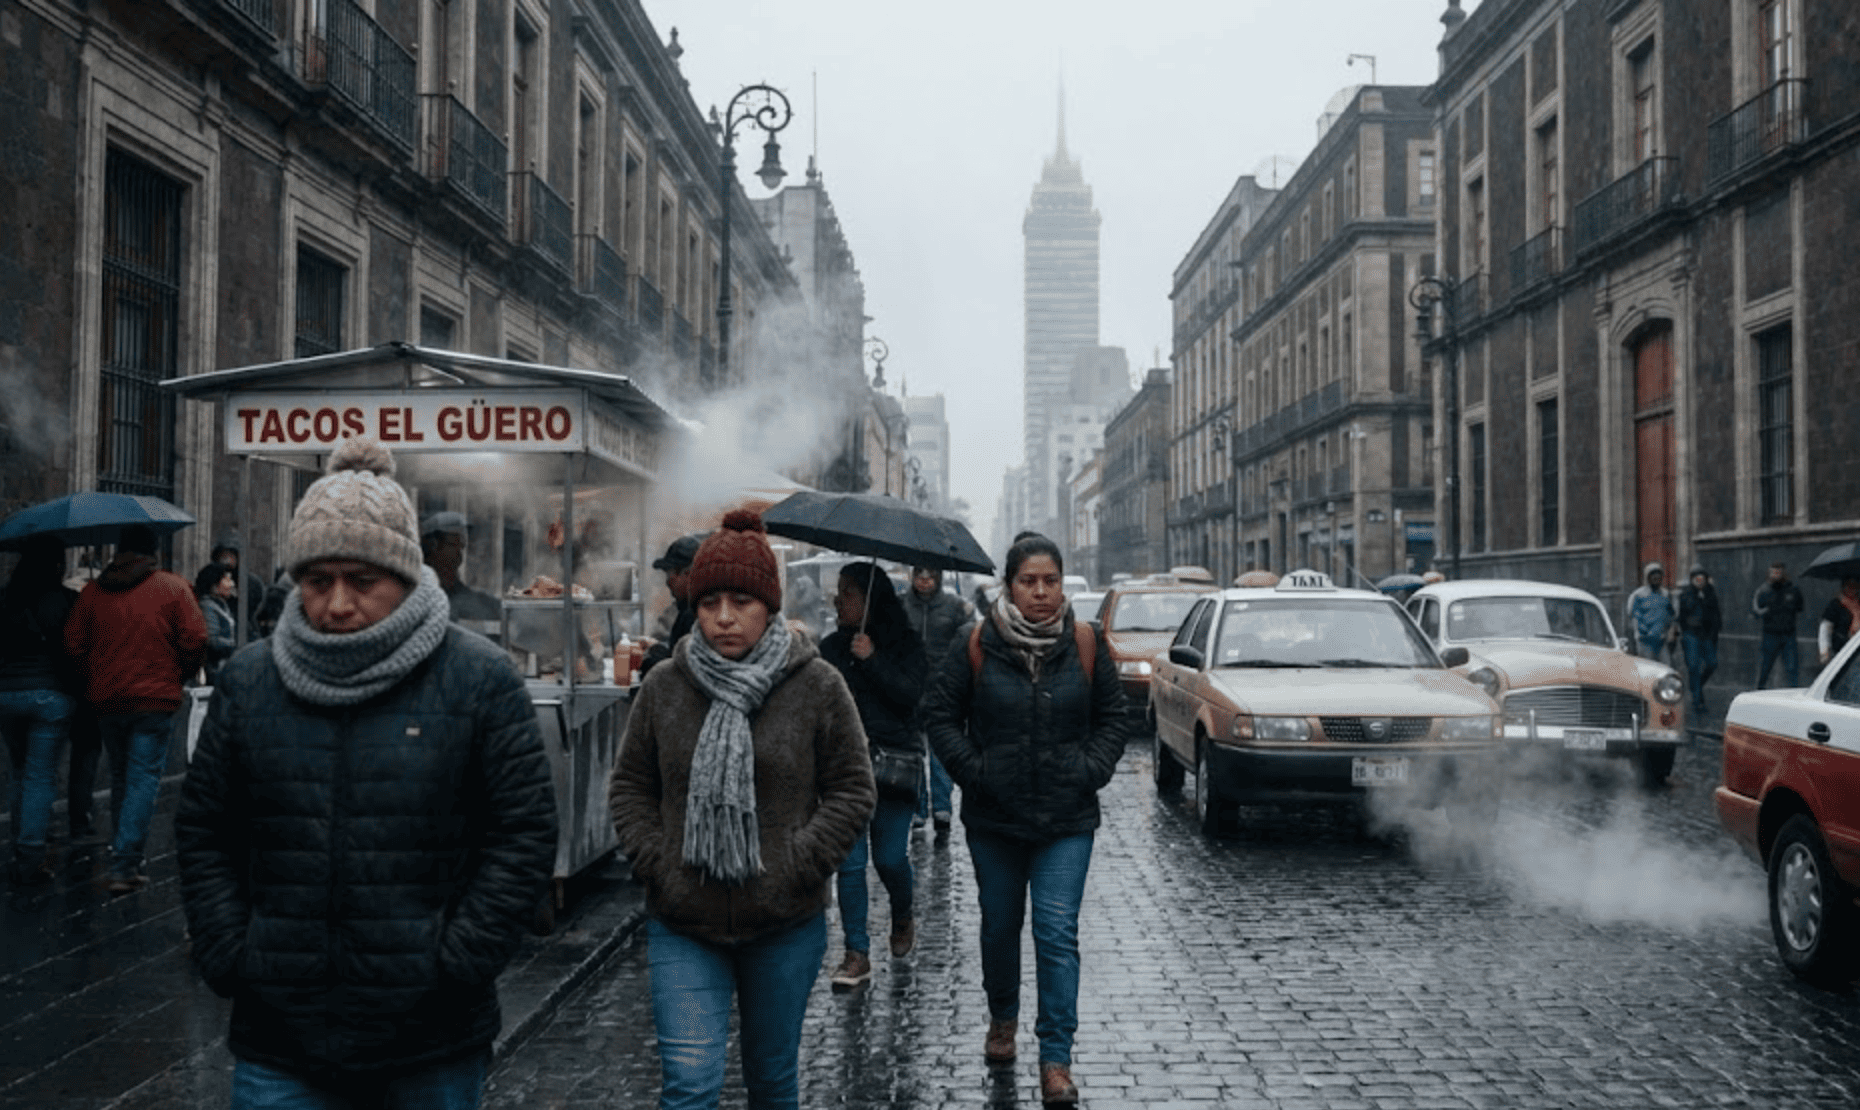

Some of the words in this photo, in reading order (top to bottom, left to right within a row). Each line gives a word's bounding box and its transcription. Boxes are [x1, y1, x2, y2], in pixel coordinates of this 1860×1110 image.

[237, 408, 365, 443] TACOS
[379, 407, 424, 441] EL
[437, 399, 572, 441] GÜERO
